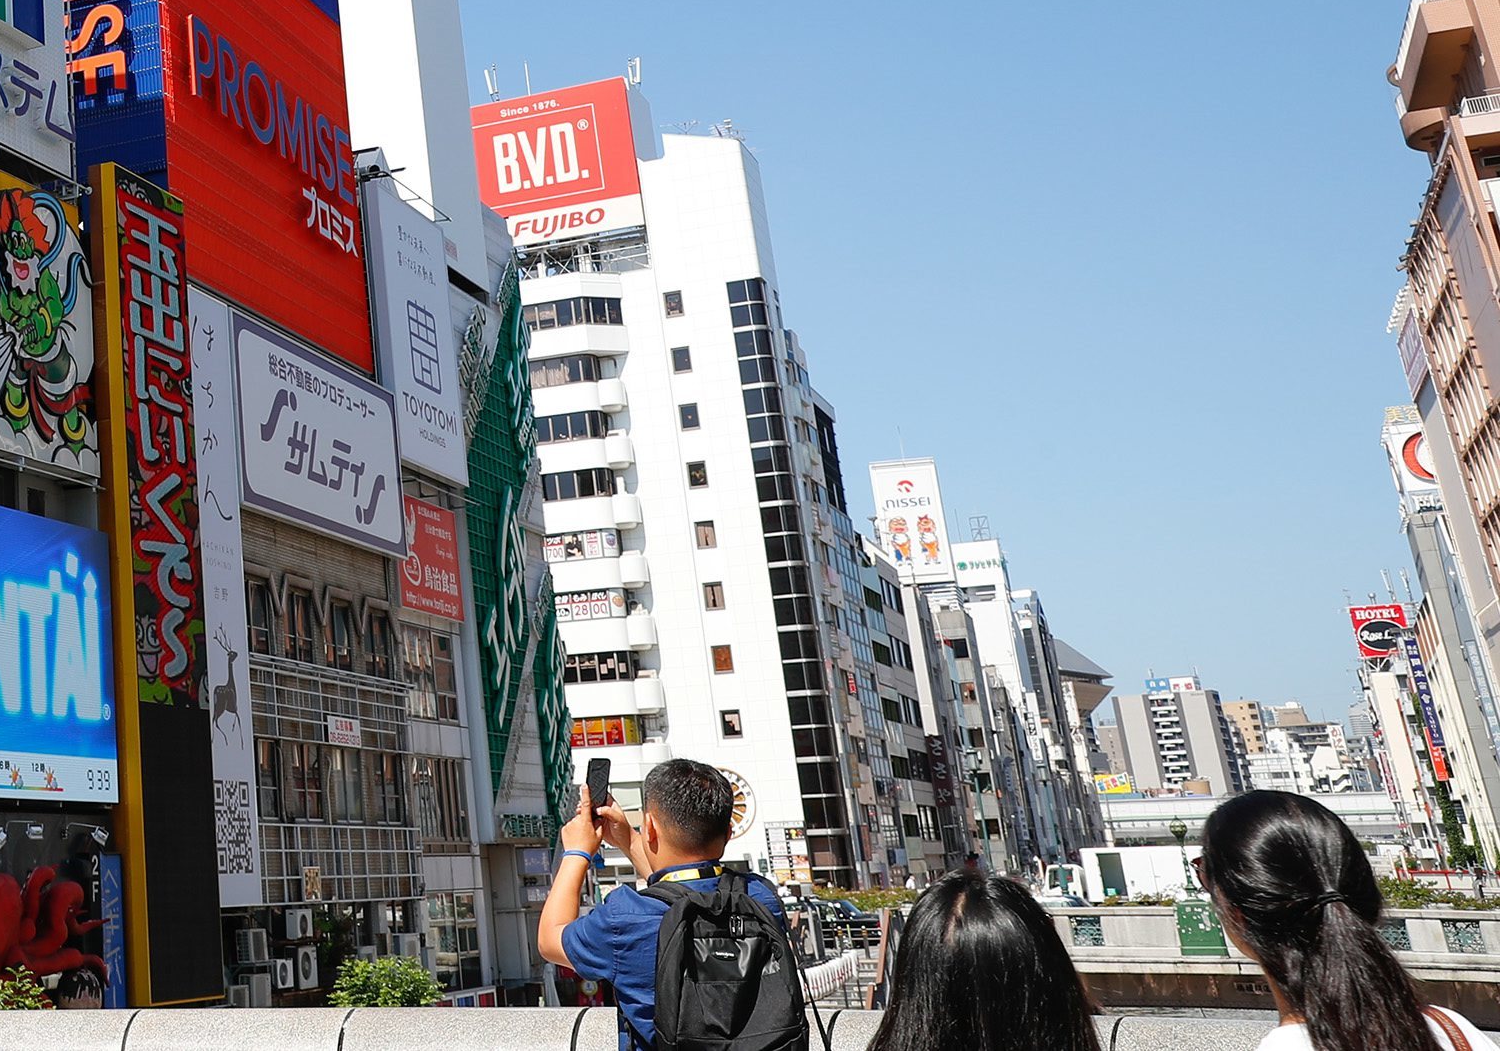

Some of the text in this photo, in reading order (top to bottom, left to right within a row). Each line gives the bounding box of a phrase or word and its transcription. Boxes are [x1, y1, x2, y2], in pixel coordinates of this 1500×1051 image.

[188, 14, 355, 207] PROMISE
[499, 105, 530, 119] Since
[492, 121, 590, 194] B.V.D.
[301, 186, 359, 259] プロミス
[513, 207, 606, 238] FUJIBO
[267, 351, 376, 419] 総合不動産のプロデューサー
[401, 390, 459, 437] TOYOTOMI
[284, 420, 366, 498] サムティ
[574, 604, 589, 616] 28
[594, 602, 609, 614] 00
[1355, 607, 1400, 620] HOTEL
[31, 762, 46, 773] 12時
